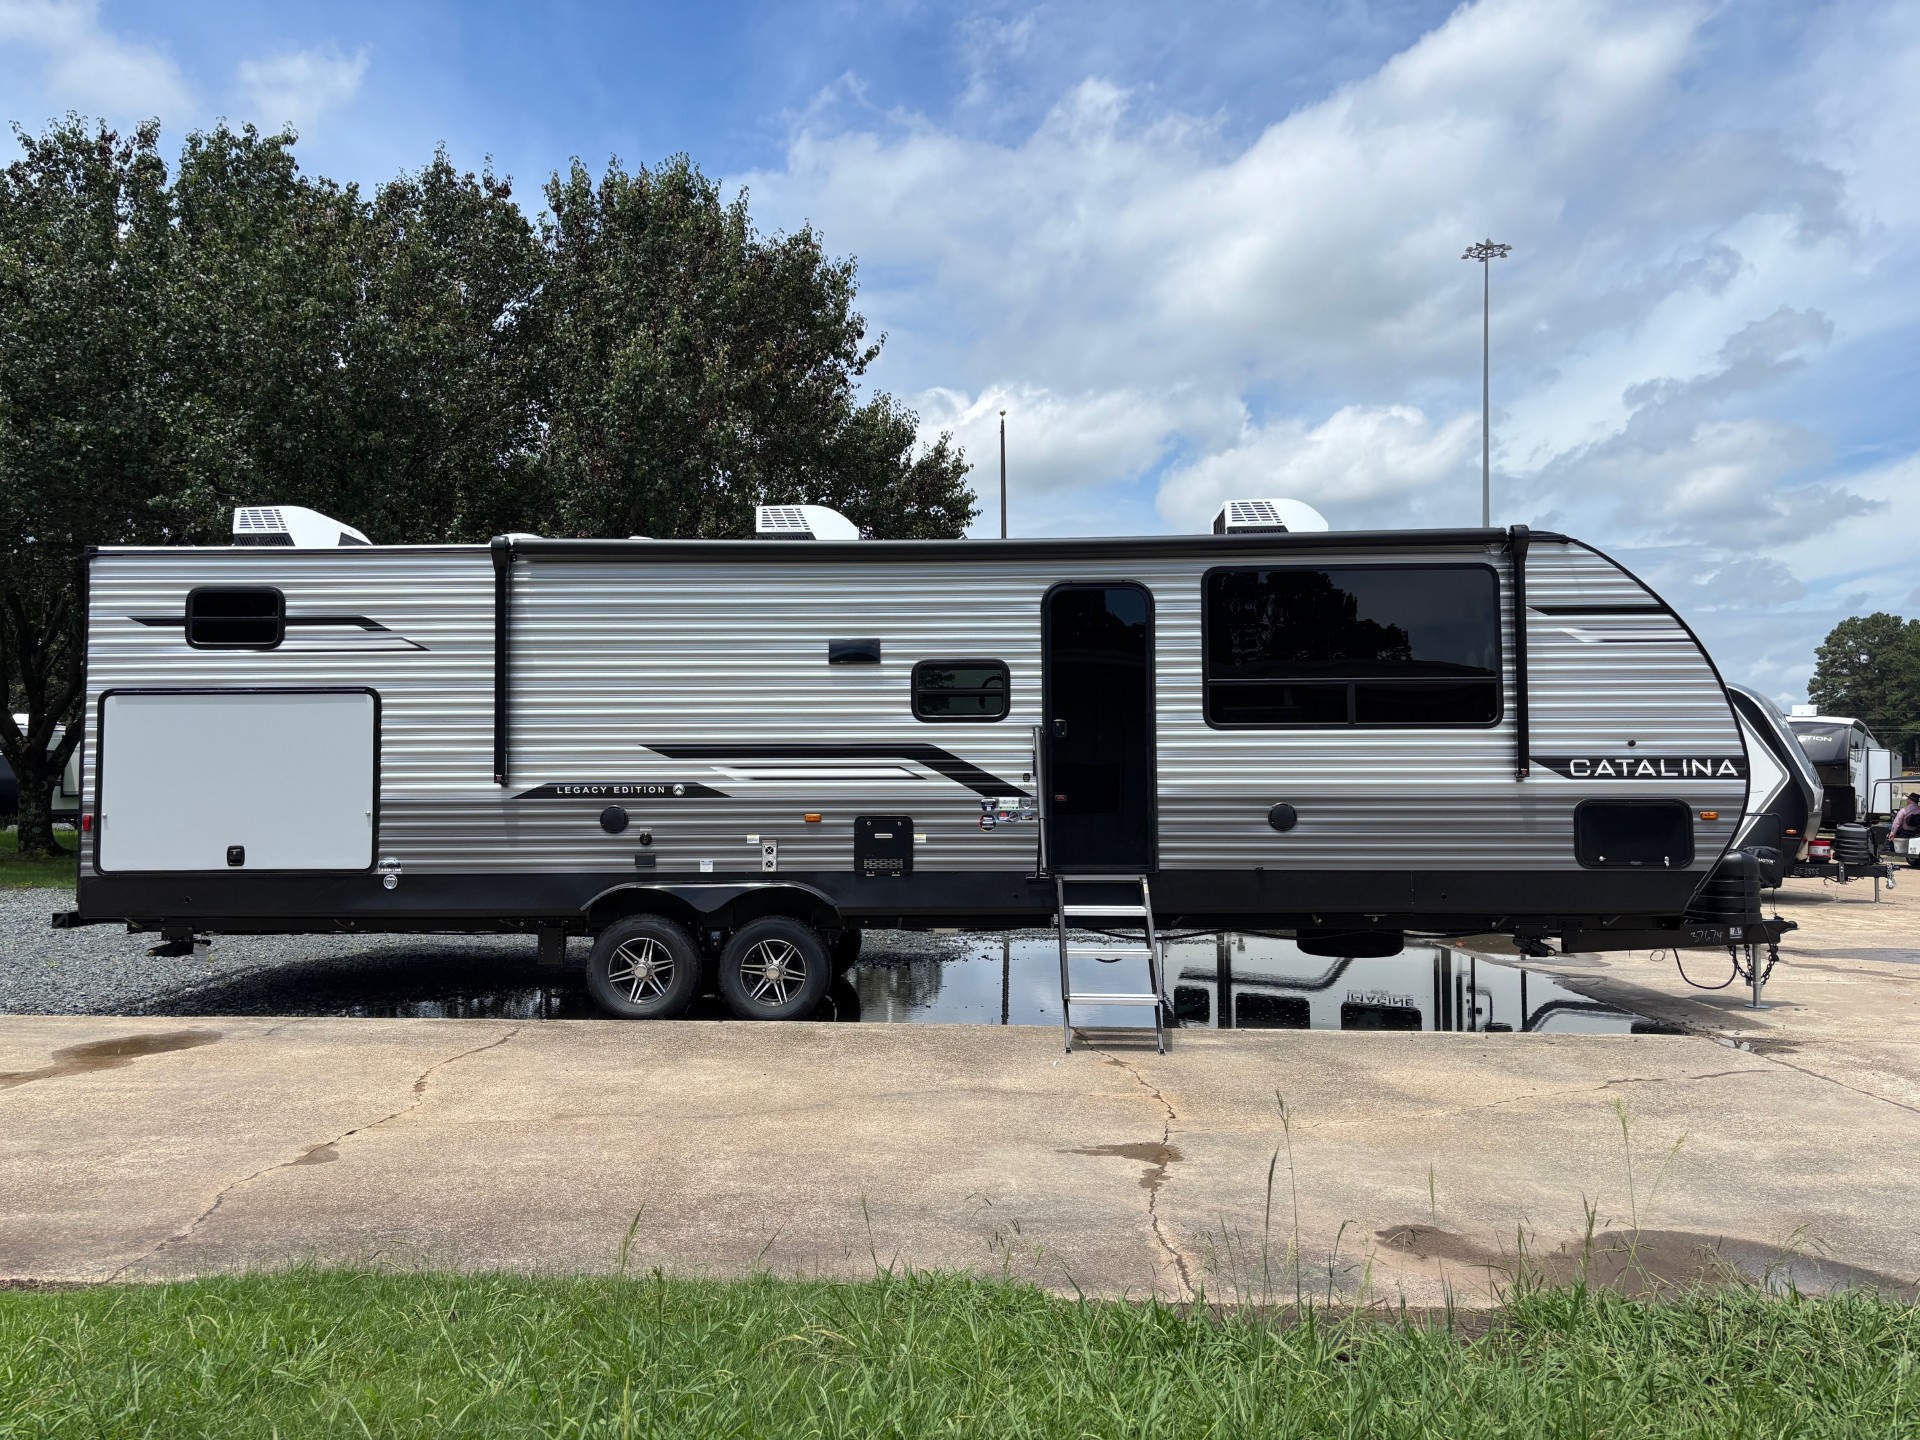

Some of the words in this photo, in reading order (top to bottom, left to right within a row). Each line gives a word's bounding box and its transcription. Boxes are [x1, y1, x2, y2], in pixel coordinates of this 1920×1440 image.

[1569, 758, 1739, 777] CATALINA
[556, 786, 608, 795] LEGACY
[613, 786, 665, 795] EDITION
[1690, 929, 1724, 944] 37674
